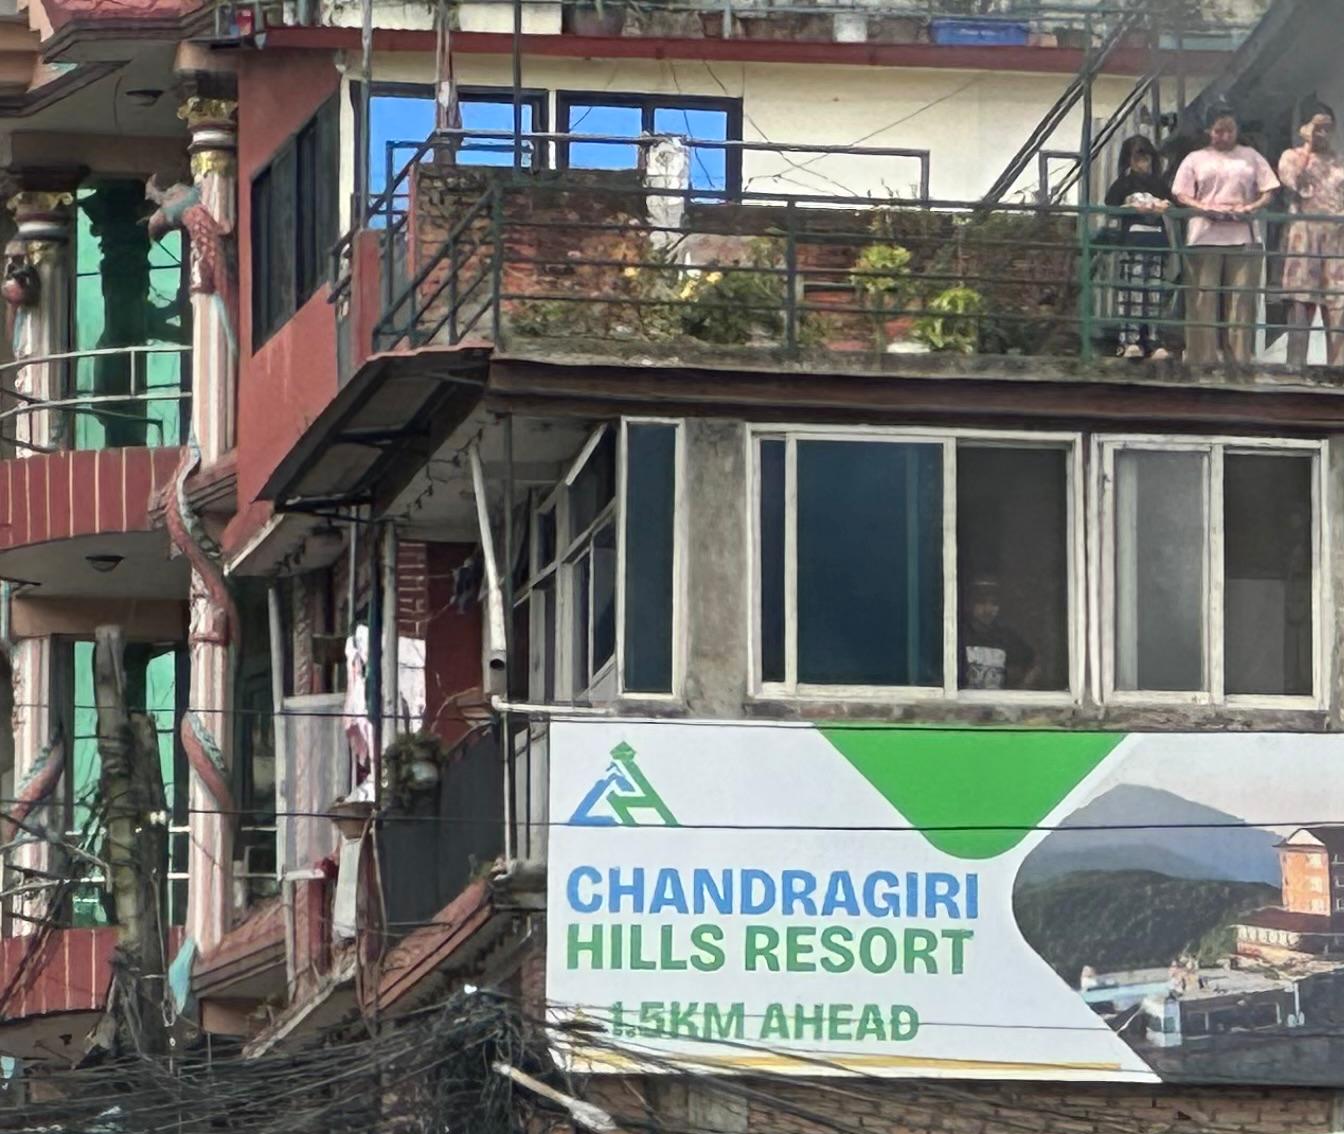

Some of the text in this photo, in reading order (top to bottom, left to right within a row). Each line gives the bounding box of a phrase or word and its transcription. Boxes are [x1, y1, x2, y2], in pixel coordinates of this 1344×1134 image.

[566, 865, 979, 919] CHANDRAGIRI
[566, 923, 976, 974] HILLS RESORT
[610, 1000, 920, 1041] 1.5KM AHEAD
